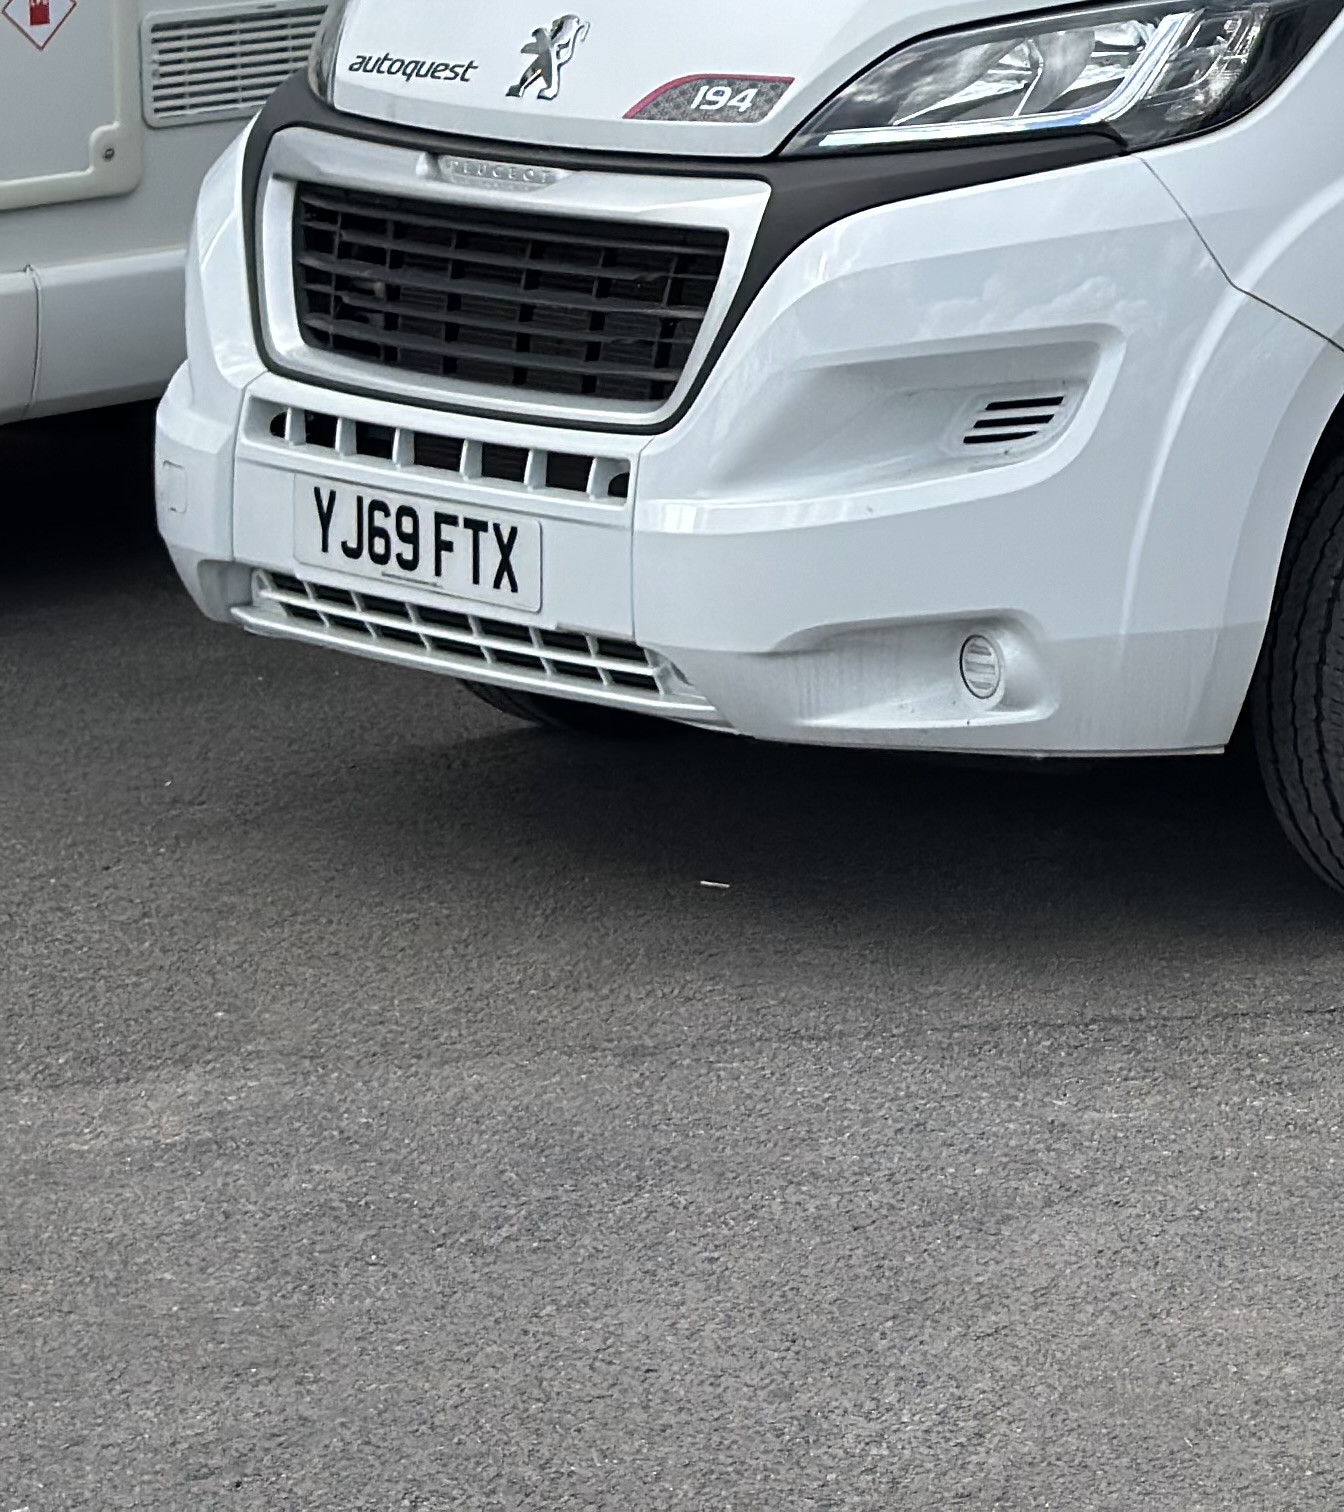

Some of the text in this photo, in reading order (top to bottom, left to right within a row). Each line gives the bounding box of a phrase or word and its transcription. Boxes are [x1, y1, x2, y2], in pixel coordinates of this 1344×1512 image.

[348, 52, 479, 83] autoquest
[690, 85, 760, 113] 194
[313, 486, 518, 593] YJ69 FTX
